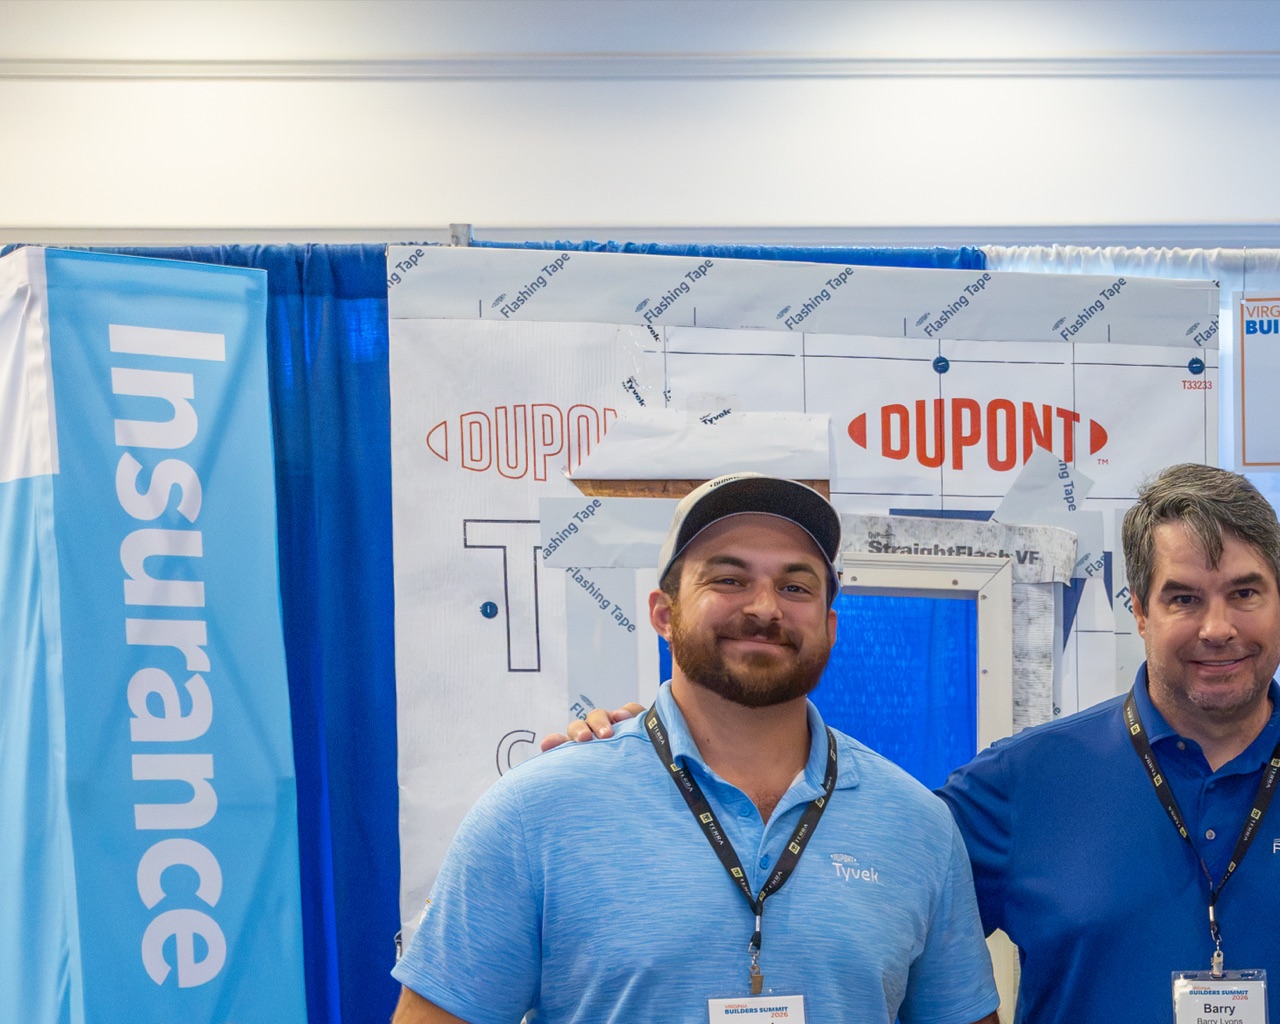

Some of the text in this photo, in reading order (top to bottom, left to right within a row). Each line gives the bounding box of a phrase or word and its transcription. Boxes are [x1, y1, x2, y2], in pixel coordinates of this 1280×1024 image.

[395, 248, 425, 274] Tape
[500, 274, 547, 318] Flashing
[542, 252, 571, 277] Tape
[643, 280, 690, 324] Flashing
[685, 259, 713, 283] Tape
[784, 288, 831, 330] Flashing
[826, 267, 854, 291] Tape
[923, 295, 969, 338] Flashing
[964, 272, 992, 297] Tape
[1060, 277, 1127, 341] Flashing Tape
[1182, 380, 1212, 390] T33233
[881, 398, 1080, 471] DUPONT
[573, 498, 602, 524] Tape
[1062, 480, 1076, 511] Tape
[1016, 550, 1040, 565] VF
[565, 566, 636, 633] Flashing Tape
[109, 324, 227, 988] Insurance
[709, 822, 724, 846] TERRA
[832, 862, 879, 883] Tyvek
[1204, 1004, 1235, 1016] Barry
